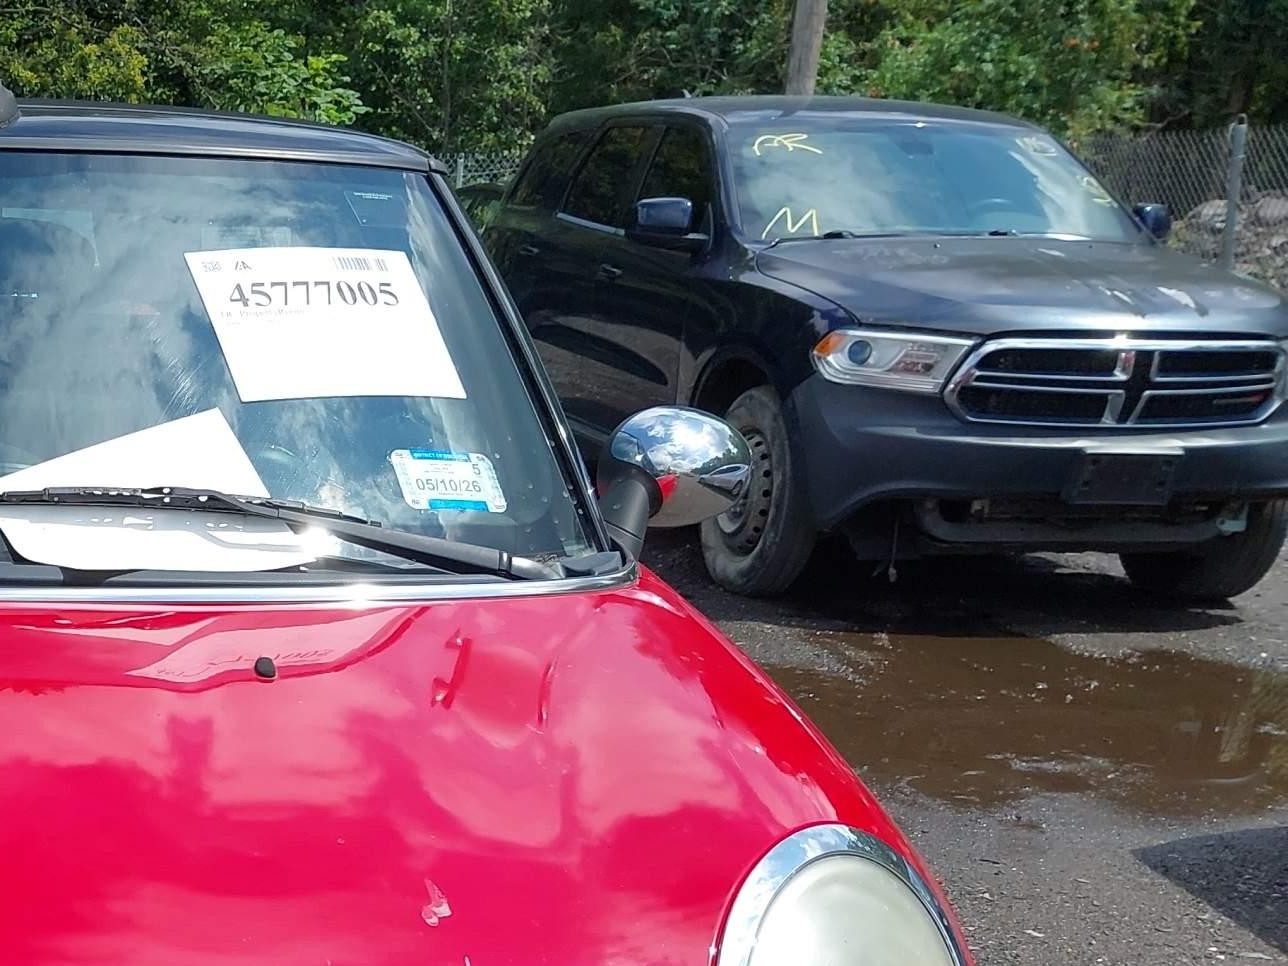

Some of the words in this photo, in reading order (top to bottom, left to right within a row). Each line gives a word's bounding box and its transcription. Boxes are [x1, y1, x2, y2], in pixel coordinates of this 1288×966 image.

[761, 206, 819, 240] M
[229, 281, 400, 307] 45777005
[472, 464, 481, 476] 5
[415, 478, 482, 493] 05/10/26
